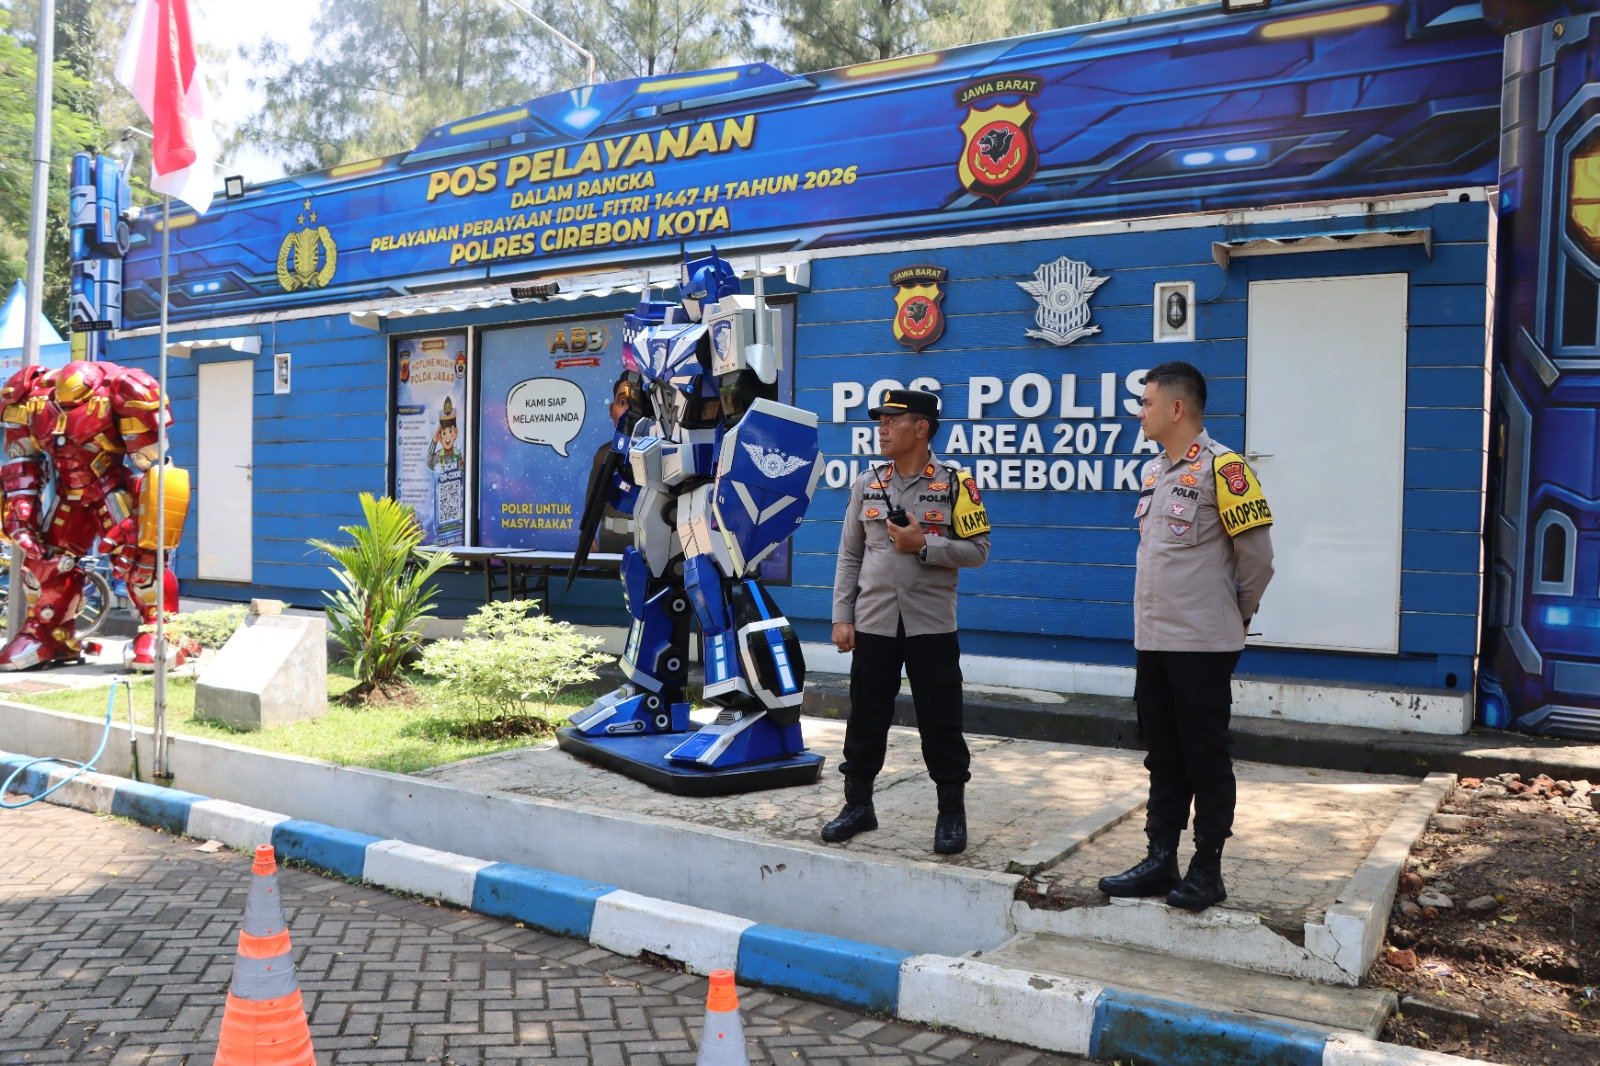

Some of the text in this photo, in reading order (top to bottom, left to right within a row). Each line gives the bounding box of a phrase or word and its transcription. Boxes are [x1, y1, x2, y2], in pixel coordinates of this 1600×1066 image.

[962, 80, 1037, 102] JAWA BARAT
[427, 114, 755, 201] POS PELAYANAN
[511, 171, 655, 209] DALAM RANGKA
[370, 165, 858, 252] PELAYANAN PERAYAAN IDUL FITRI 1447 H TAHUN 2026
[450, 206, 730, 265] POLRES CIREBON KOTA
[893, 268, 942, 281] JAWA BARAT
[550, 327, 603, 353] AB3
[412, 358, 453, 371] HOTLINE MUDIK
[411, 370, 455, 384] POLDA JABAR
[525, 397, 566, 407] KAMI SIAP
[968, 369, 1152, 420] POLIS
[513, 412, 579, 423] MELAYANI ANDA
[945, 423, 1045, 454] AREA
[1052, 422, 1122, 455] 207
[943, 458, 1104, 491] REBON
[919, 493, 951, 504] POLRI
[1171, 486, 1199, 500] POLRI
[501, 503, 571, 515] POLRI UNTUK
[501, 518, 573, 530] MASYARAKAT
